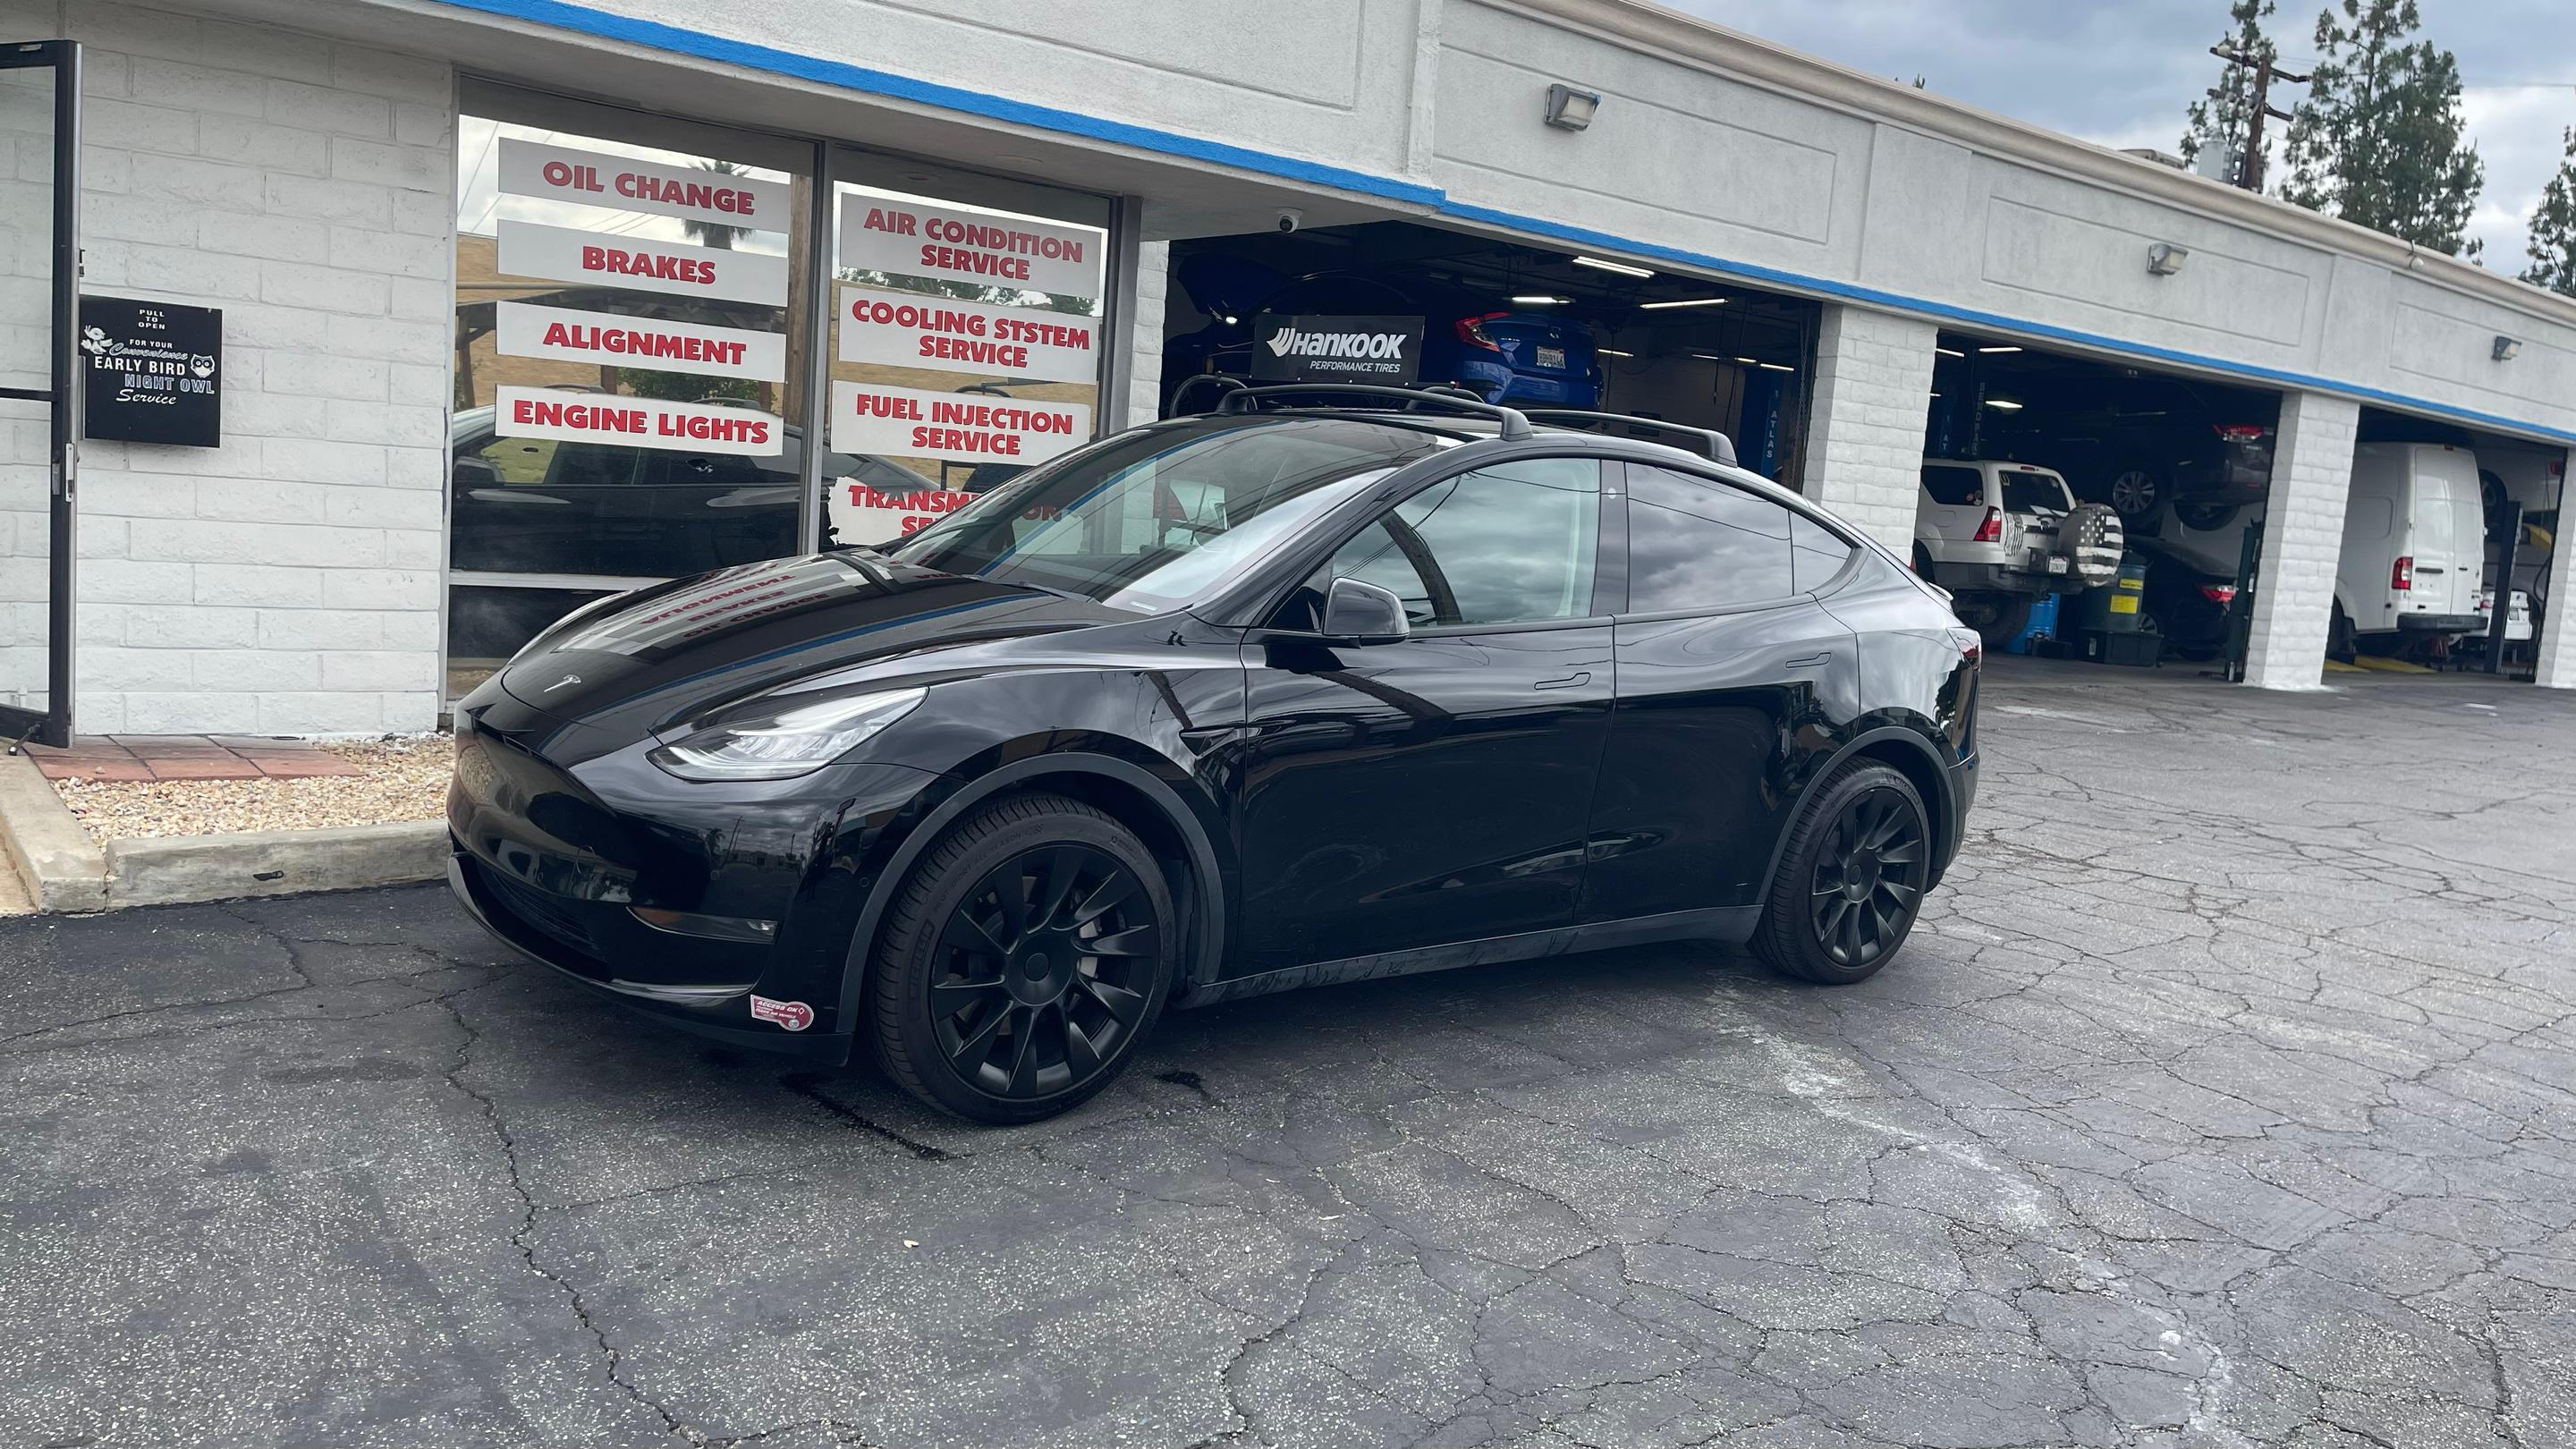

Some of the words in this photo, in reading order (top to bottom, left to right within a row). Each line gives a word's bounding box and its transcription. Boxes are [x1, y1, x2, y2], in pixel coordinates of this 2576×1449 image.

[543, 162, 605, 192] OIL
[615, 173, 755, 216] CHANGE
[864, 208, 916, 236] AIR
[925, 218, 1082, 263] CONDITION
[582, 246, 716, 284] BRAKES
[920, 244, 1030, 281] SERVICE
[138, 321, 165, 330] OPEN
[139, 309, 165, 317] PULL
[852, 300, 986, 336] COOLING
[994, 318, 1089, 350] STSTEM
[108, 342, 189, 361] Convenience
[129, 338, 147, 347] FOR
[149, 340, 173, 349] YOUR
[543, 322, 747, 366] ALIGNMENT
[919, 335, 1028, 368] SERVICE
[94, 355, 142, 372] EARLY
[148, 357, 187, 376] BIRD
[1309, 360, 1374, 372] PERFORMANCE
[1375, 363, 1402, 374] TIRES
[115, 388, 177, 405] Service
[124, 373, 174, 391] NIGHT
[180, 378, 216, 394] OWL
[513, 399, 648, 435] ENGINE
[657, 413, 769, 445] LIGHTS
[856, 394, 924, 421] FUEL
[931, 401, 1073, 435] INJECTION
[911, 426, 1021, 456] SERVICE
[1767, 410, 1778, 459] ATLAS
[757, 1000, 786, 1011] ACCESS
[786, 1005, 798, 1013] OK
